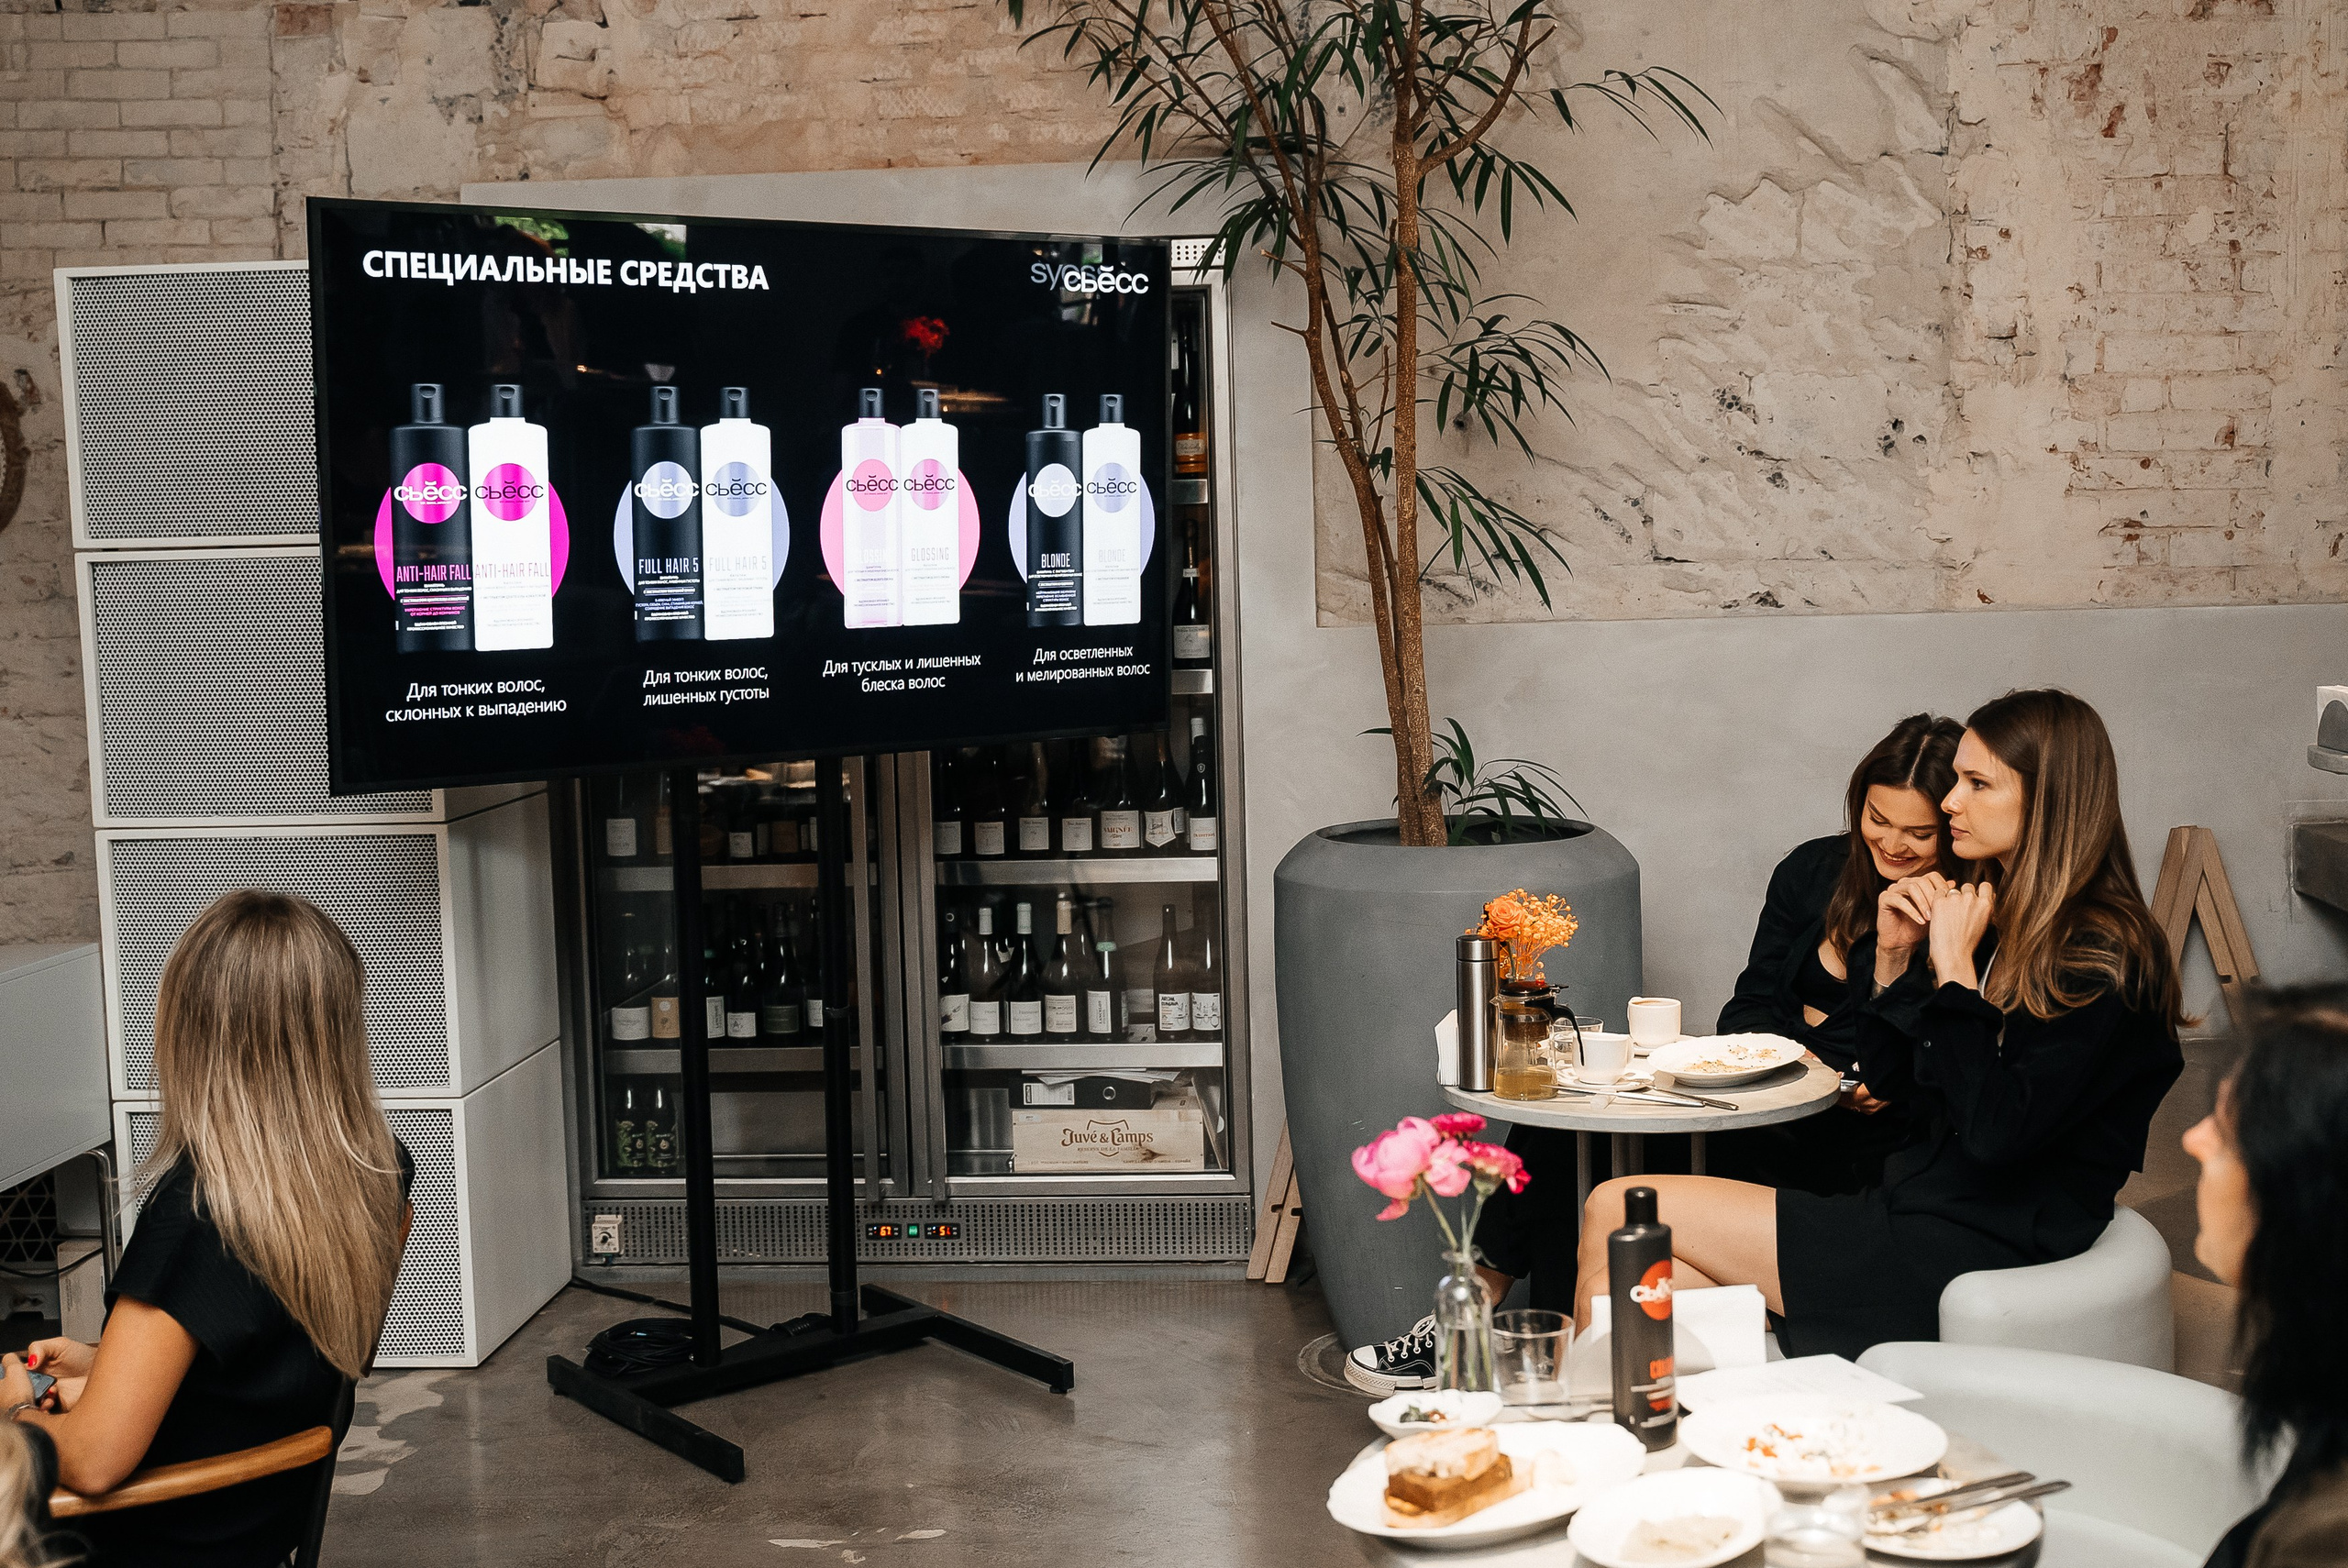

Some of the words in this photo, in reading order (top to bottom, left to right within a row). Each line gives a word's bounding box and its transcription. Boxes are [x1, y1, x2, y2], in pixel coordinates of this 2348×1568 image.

[363, 249, 612, 286] СПЕЦИАЛЬНЫЕ
[620, 260, 770, 293] СРЕДСТВА
[911, 547, 949, 561] GLOSSING
[1041, 553, 1071, 569] BLONDE
[396, 564, 448, 582] ANTI-HAIR
[449, 564, 472, 581] FALL
[475, 563, 525, 579] ANTI-HAIR
[528, 562, 549, 578] FALL
[638, 558, 662, 574] FULL
[666, 558, 690, 574] HAIR
[693, 557, 699, 573] 5
[1034, 648, 1056, 665] Для
[1060, 646, 1133, 660] осветленных
[823, 660, 847, 677] Для
[851, 659, 902, 676] тусклых
[905, 659, 913, 668] и
[916, 656, 980, 668] лишенных
[1016, 672, 1024, 682] и
[1027, 668, 1113, 683] мелированных
[1117, 665, 1150, 676] волос
[643, 670, 670, 688] Для
[674, 670, 721, 682] тонких
[725, 668, 768, 679] волос,
[862, 679, 904, 692] блеска
[909, 677, 946, 689] волос
[406, 683, 437, 701] Для
[441, 682, 493, 696] тонких
[498, 679, 545, 693] волос,
[643, 691, 716, 706] лишенных
[721, 688, 769, 704] густоты
[386, 707, 461, 722] склонных
[466, 706, 474, 716] к
[479, 700, 566, 716] выпадению
[1061, 1128, 1097, 1146] Juvé
[1100, 1134, 1109, 1143] &
[1111, 1127, 1154, 1146] Camps
